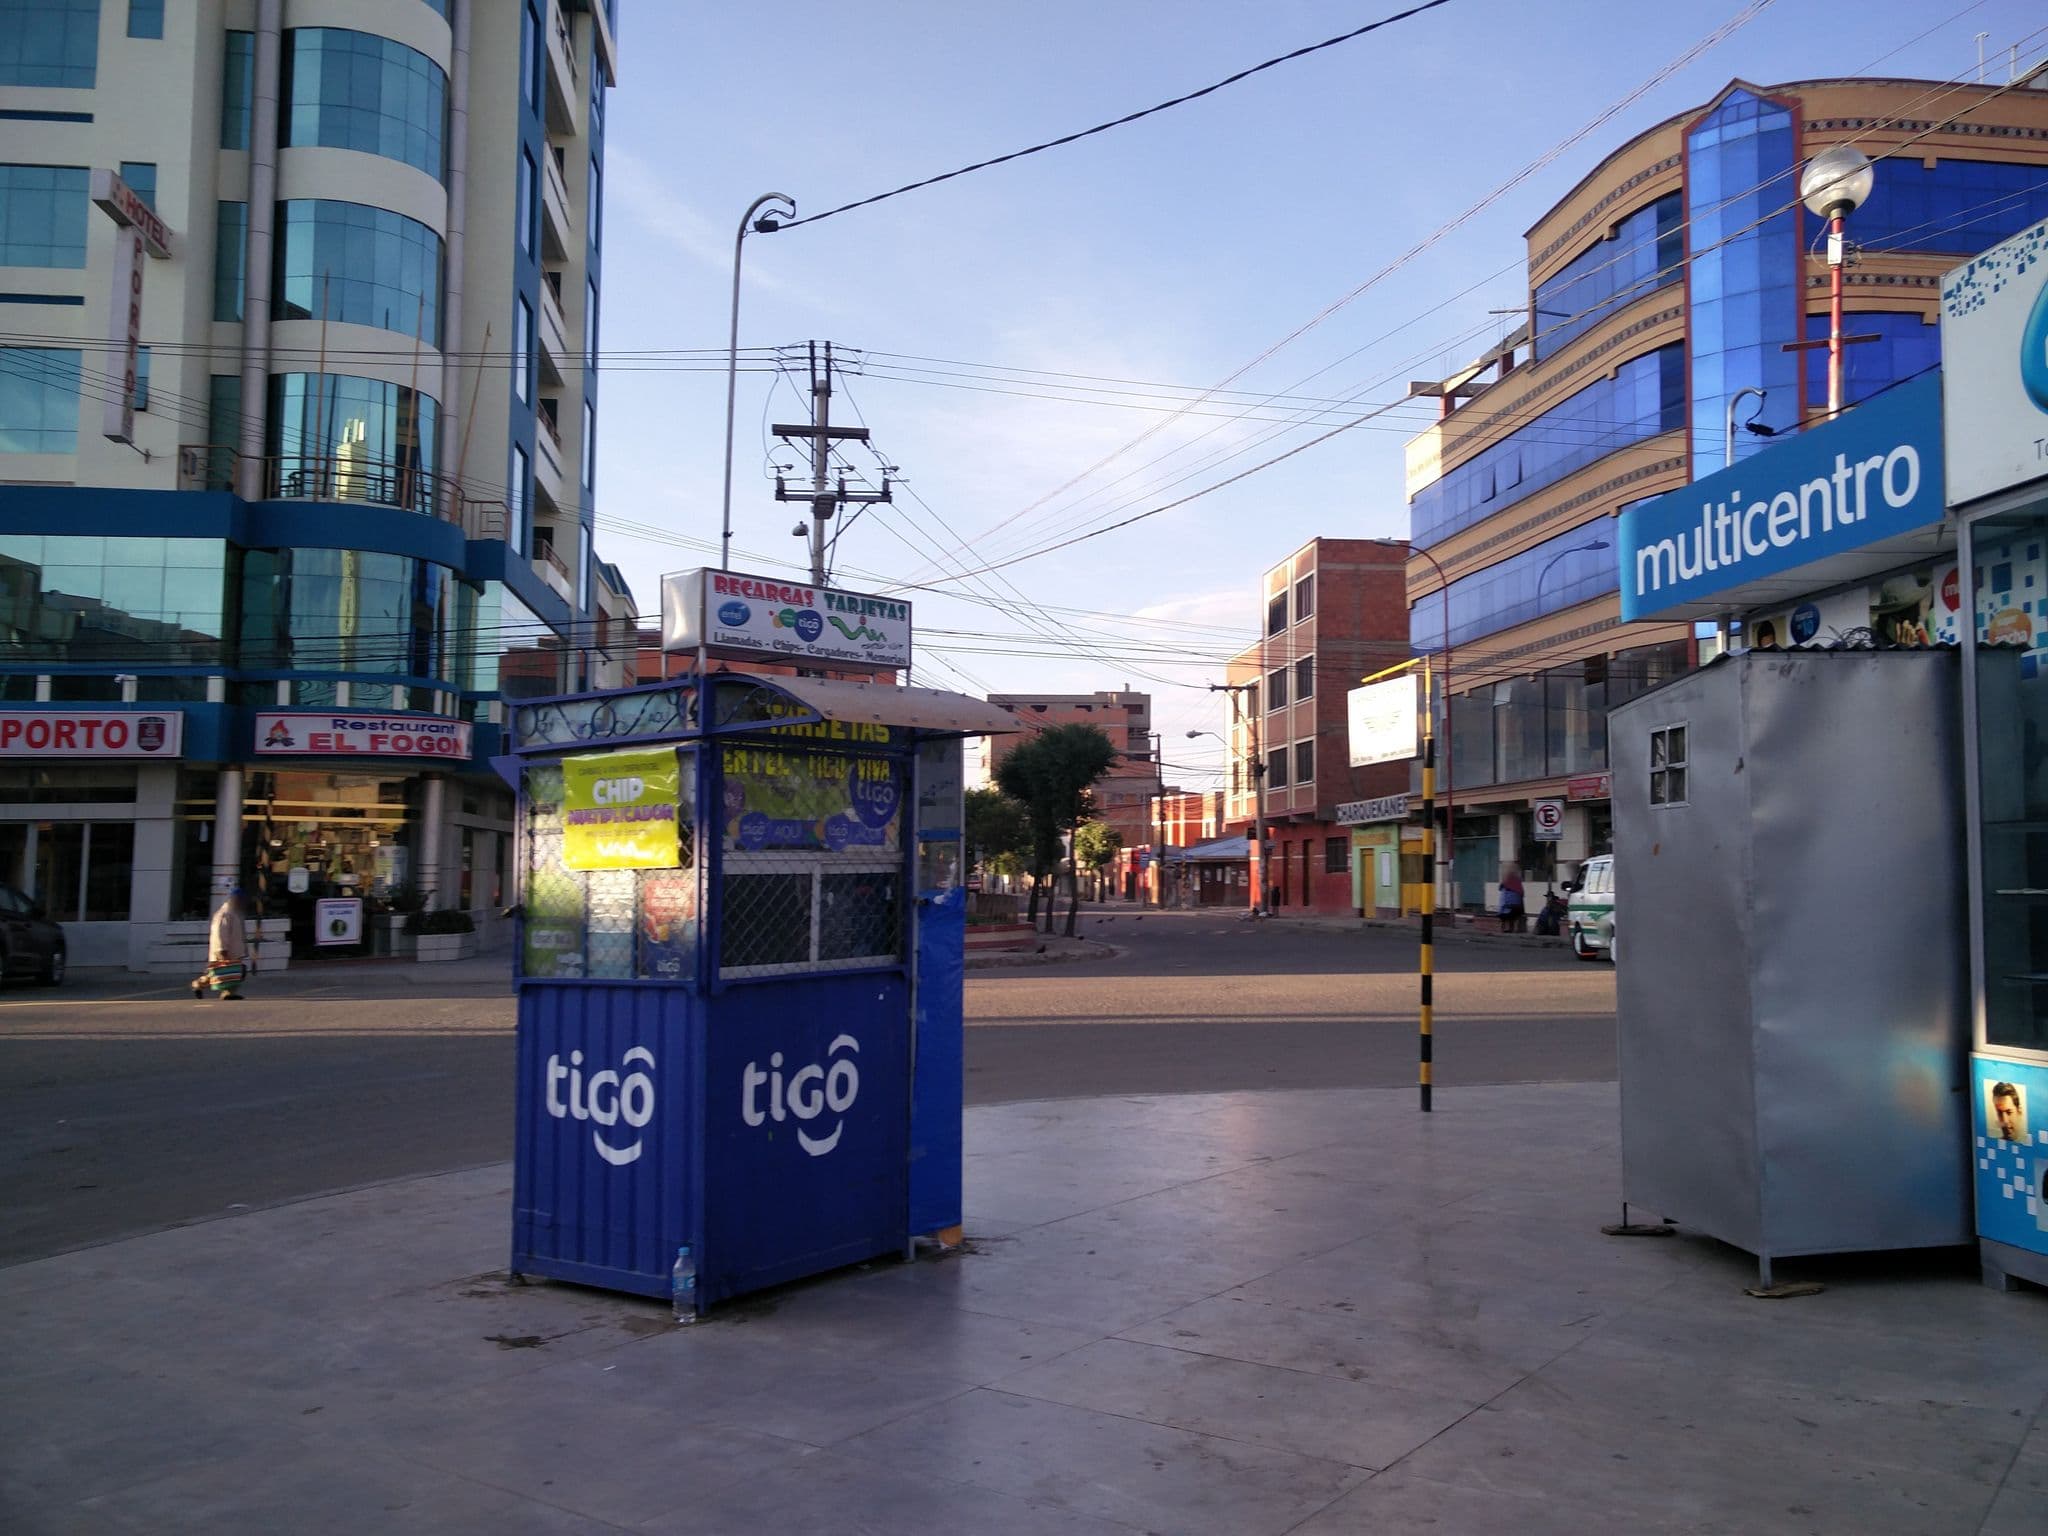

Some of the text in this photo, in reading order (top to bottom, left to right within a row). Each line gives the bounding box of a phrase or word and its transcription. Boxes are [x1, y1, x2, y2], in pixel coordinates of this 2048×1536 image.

[125, 189, 168, 251] HOTEL
[124, 236, 142, 394] PORTO
[1637, 445, 1920, 596] multicentro
[714, 575, 906, 621] RECARGAS TARJETAS
[798, 616, 820, 632] tigo
[714, 632, 763, 648] Llamadas
[865, 650, 907, 665] Memorias
[0, 718, 128, 749] PORTO
[309, 732, 465, 754] EL FOGON
[332, 718, 456, 734] Restaurant
[592, 777, 645, 805] CHIP
[546, 1046, 656, 1128] tigo
[743, 1034, 860, 1127] tigo
